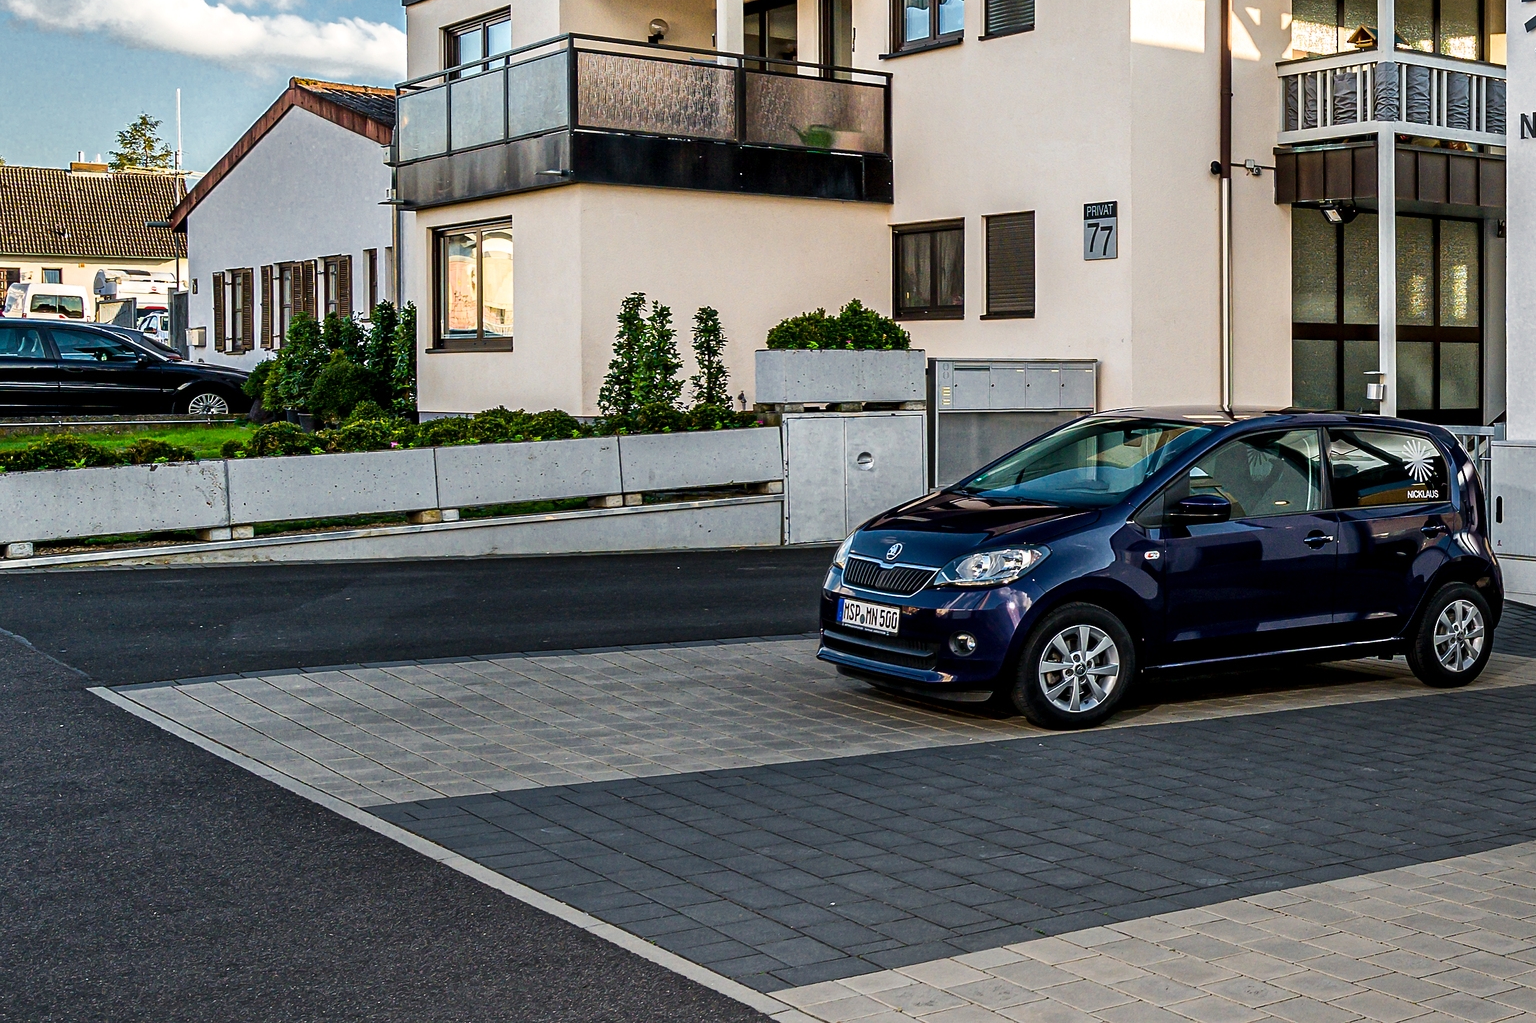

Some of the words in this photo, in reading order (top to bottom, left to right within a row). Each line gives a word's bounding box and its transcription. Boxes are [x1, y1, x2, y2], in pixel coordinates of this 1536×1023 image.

[1086, 203, 1114, 217] PRIVAT
[1087, 222, 1113, 256] 77
[1407, 489, 1439, 499] NICKLAUS
[844, 602, 861, 622] MSP
[879, 609, 898, 630] 500
